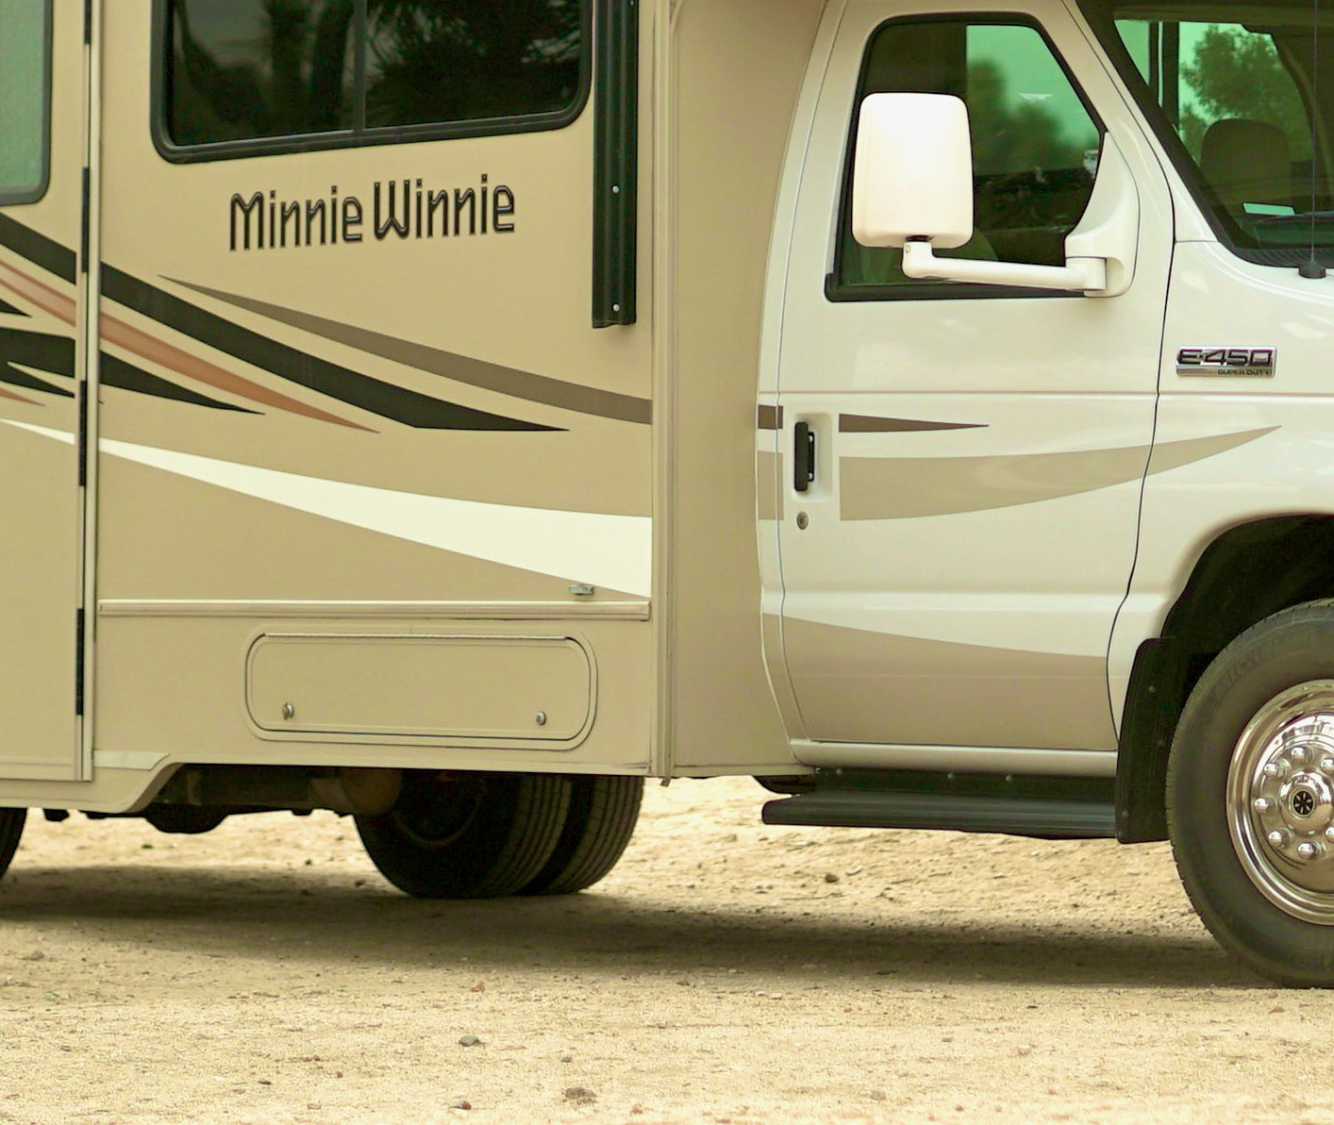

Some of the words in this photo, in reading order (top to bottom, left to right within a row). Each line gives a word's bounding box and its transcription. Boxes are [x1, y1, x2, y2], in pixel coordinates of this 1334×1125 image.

[229, 185, 364, 251] Minnie
[374, 173, 516, 240] Winnie
[1217, 368, 1245, 376] SUPER
